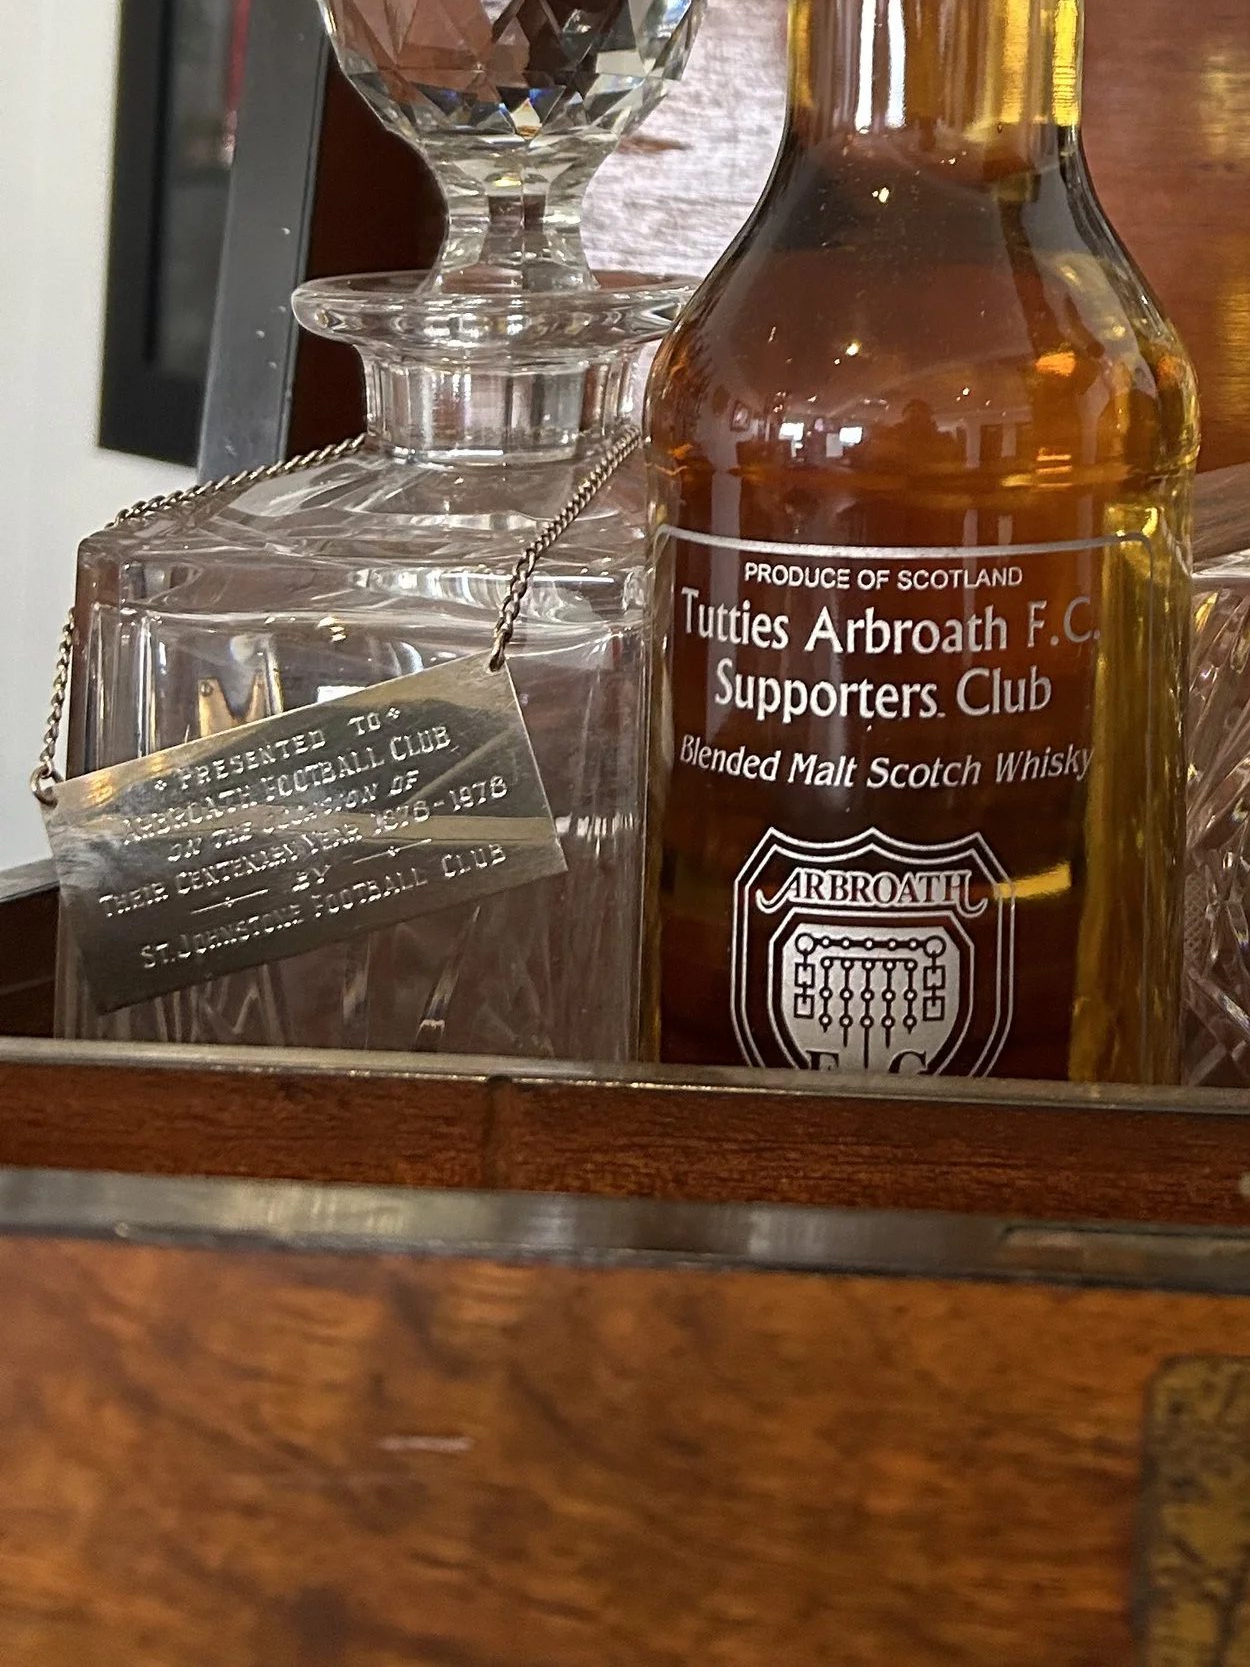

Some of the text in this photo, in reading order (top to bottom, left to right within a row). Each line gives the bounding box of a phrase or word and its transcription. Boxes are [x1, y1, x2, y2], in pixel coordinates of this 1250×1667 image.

[744, 561, 1023, 591] PRODUCE OF SCOTLAND
[681, 586, 790, 650] Tutties
[804, 604, 1008, 655] Arbroath
[956, 665, 1052, 716] Club
[177, 711, 382, 790] PRESENTED TO
[260, 746, 385, 803] FOOTBALL
[390, 725, 451, 761] CLUB
[680, 734, 1094, 790] Blended Malt Scotch Whisky
[440, 842, 507, 879] CLUB
[756, 866, 988, 918] ARBROATH
